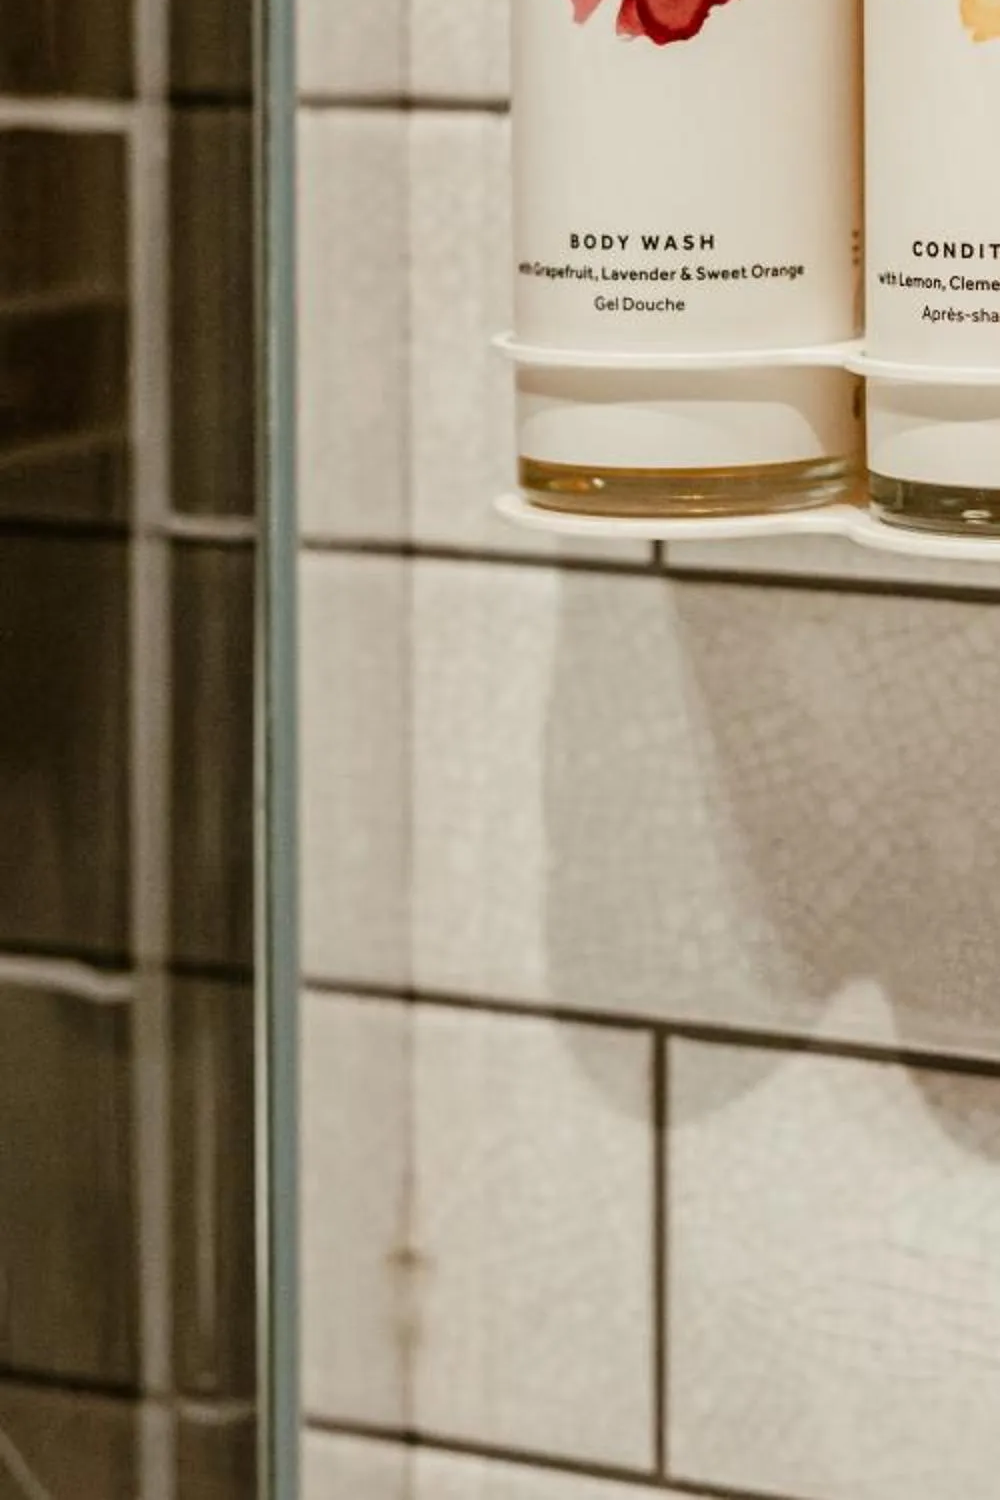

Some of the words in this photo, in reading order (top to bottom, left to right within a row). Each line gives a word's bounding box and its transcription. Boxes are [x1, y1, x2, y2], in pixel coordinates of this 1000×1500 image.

[569, 234, 630, 250] BODY
[641, 234, 715, 251] WASH
[534, 262, 600, 282] Grapefruit,
[601, 266, 676, 281] Lavender
[680, 266, 693, 281] &
[696, 266, 748, 281] Sweet
[751, 263, 805, 281] Orange
[899, 272, 946, 292] Lemon,
[594, 295, 619, 312] Gel
[623, 296, 685, 312] Douche
